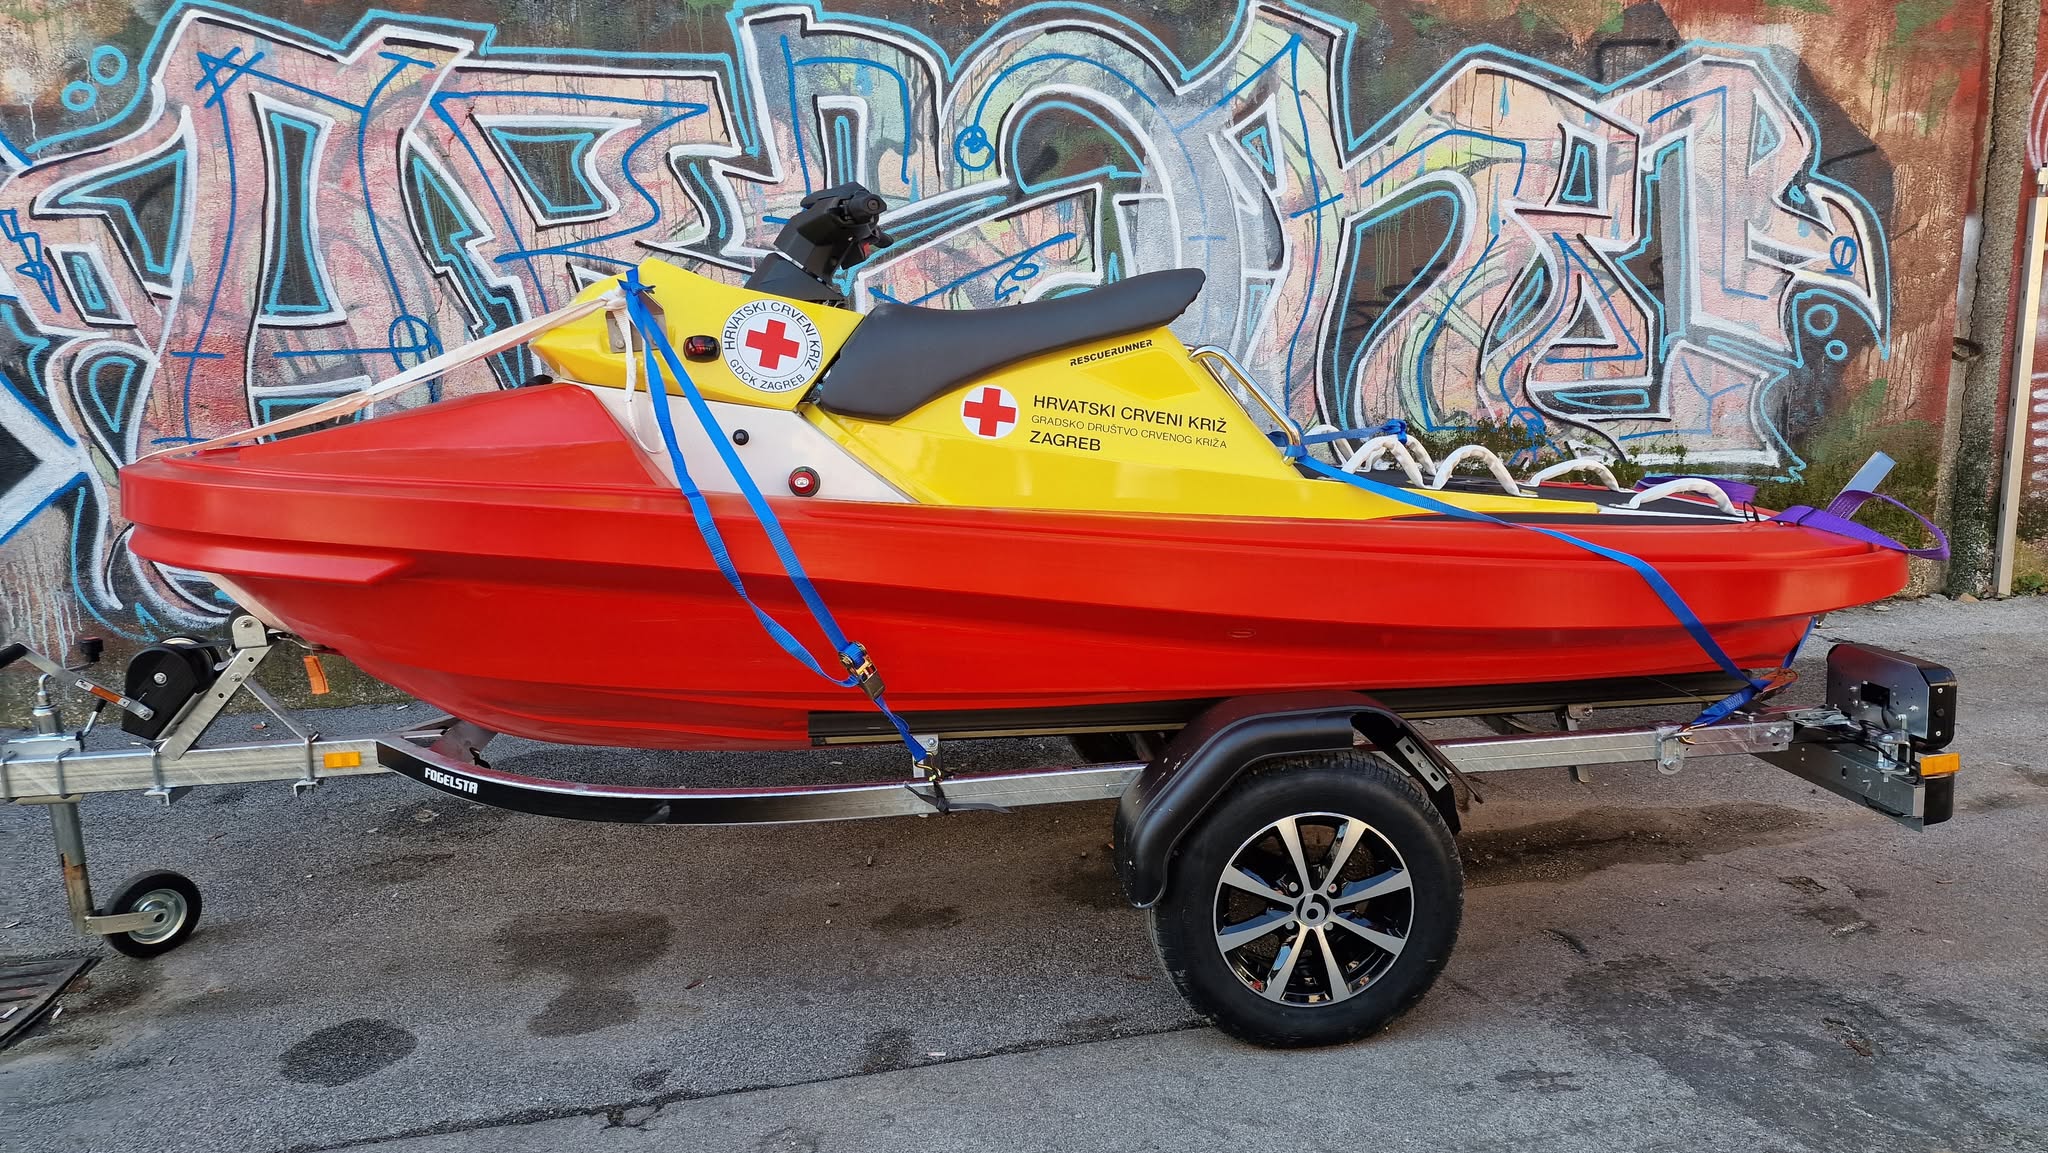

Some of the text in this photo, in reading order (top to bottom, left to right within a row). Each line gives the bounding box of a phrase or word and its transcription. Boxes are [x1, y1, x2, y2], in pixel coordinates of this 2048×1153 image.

[724, 302, 820, 371] HRVATSKI CRVENI KRIŽ
[1070, 339, 1153, 366] RESCUERUNNER
[730, 359, 805, 390] GDCK ZAGREB
[1033, 395, 1227, 433] HRVATSKI CRVENI KRIŽ
[1029, 430, 1101, 451] ZAGREB
[1031, 415, 1227, 449] GRADSKO DRUŠTVO CRVENOG KRIŽA
[425, 767, 478, 794] FOGELSTA
